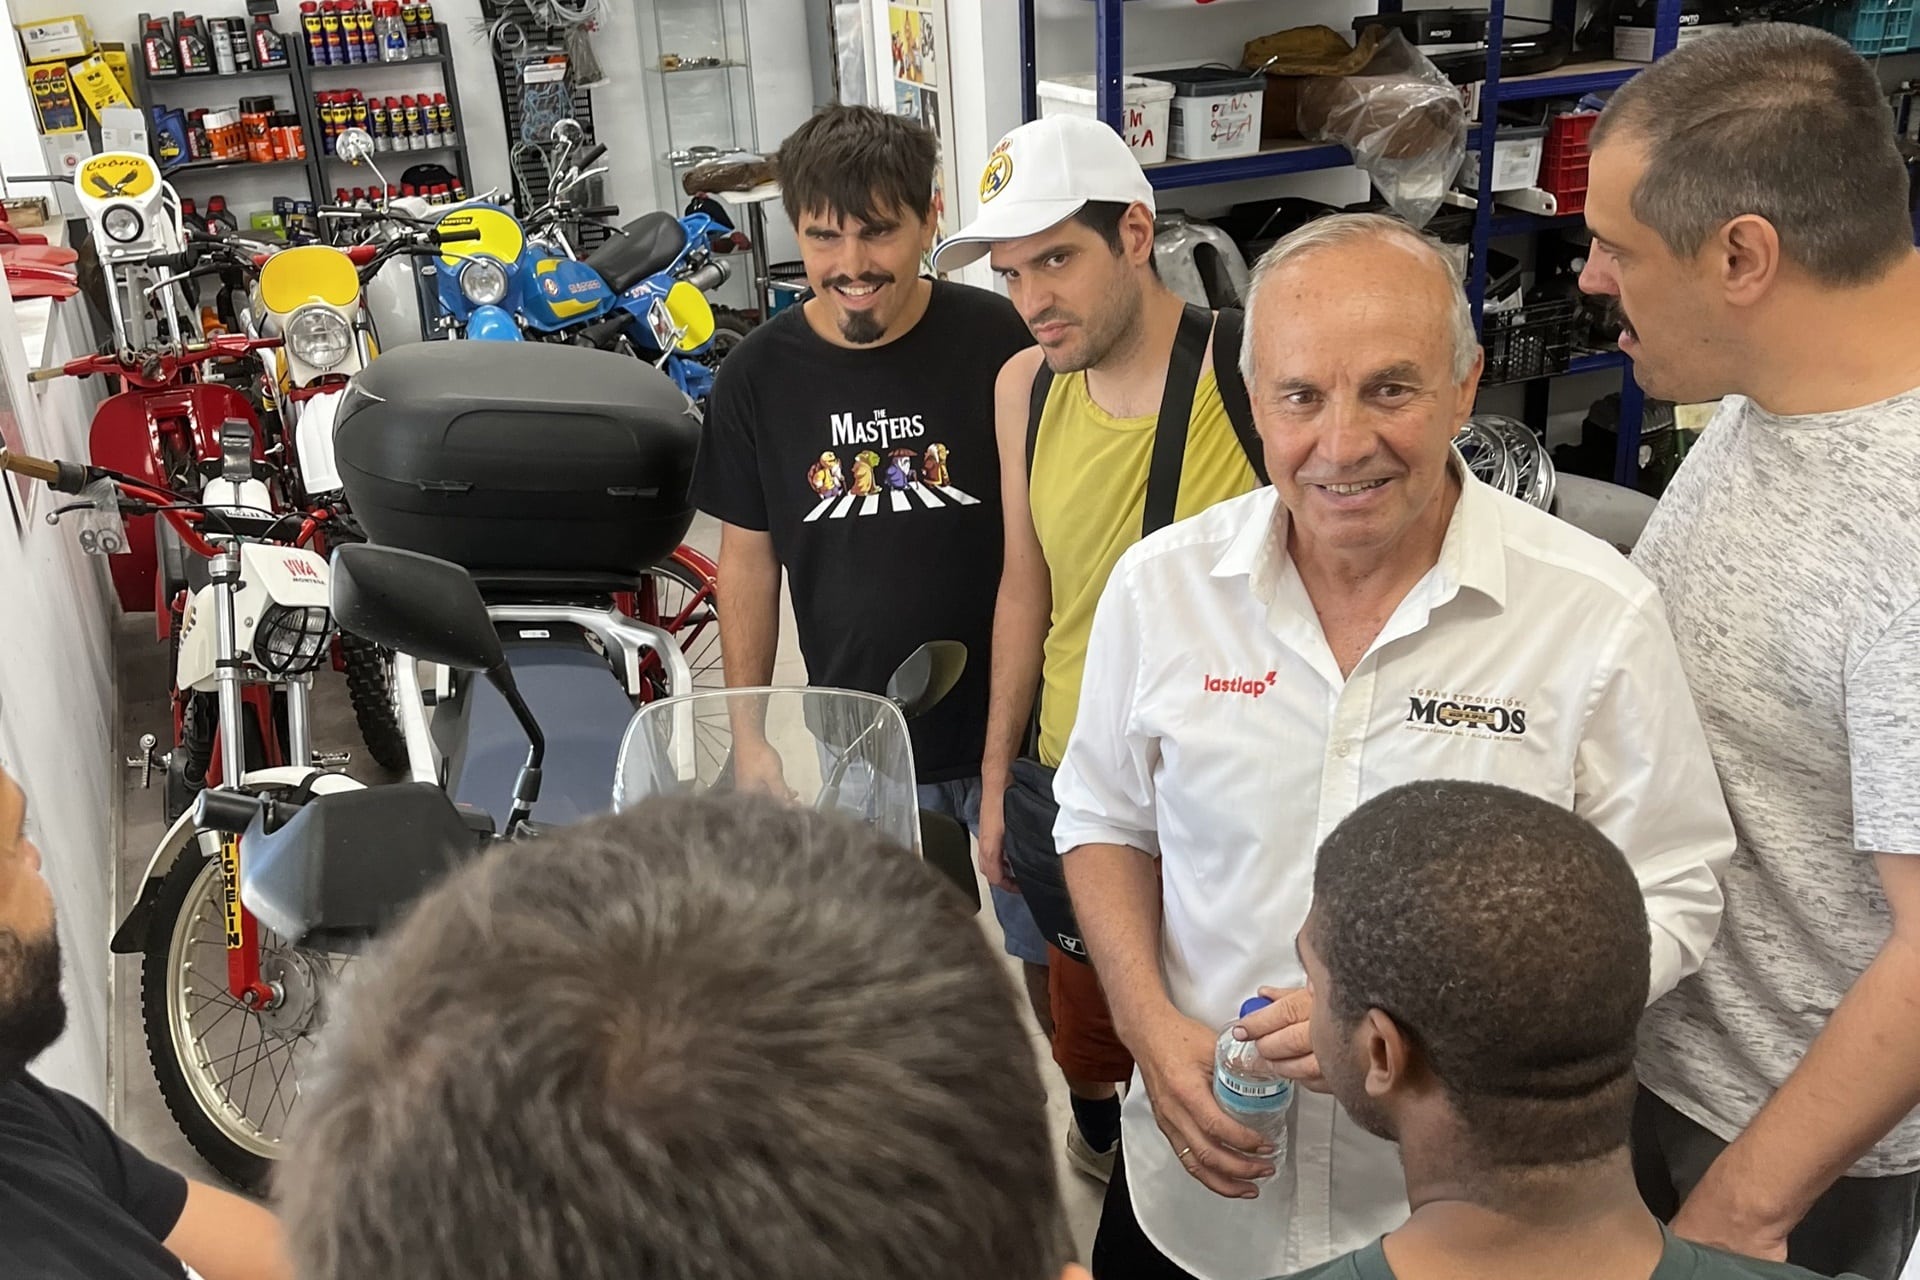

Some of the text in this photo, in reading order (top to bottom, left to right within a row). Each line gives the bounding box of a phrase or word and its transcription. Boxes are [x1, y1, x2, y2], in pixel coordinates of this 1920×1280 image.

[830, 412, 925, 448] MASTERS
[873, 409, 886, 421] THE
[283, 559, 318, 578] VIVA
[1204, 674, 1266, 698] lastlap
[1406, 697, 1526, 735] MOTOS
[222, 831, 240, 946] MICHELIN
